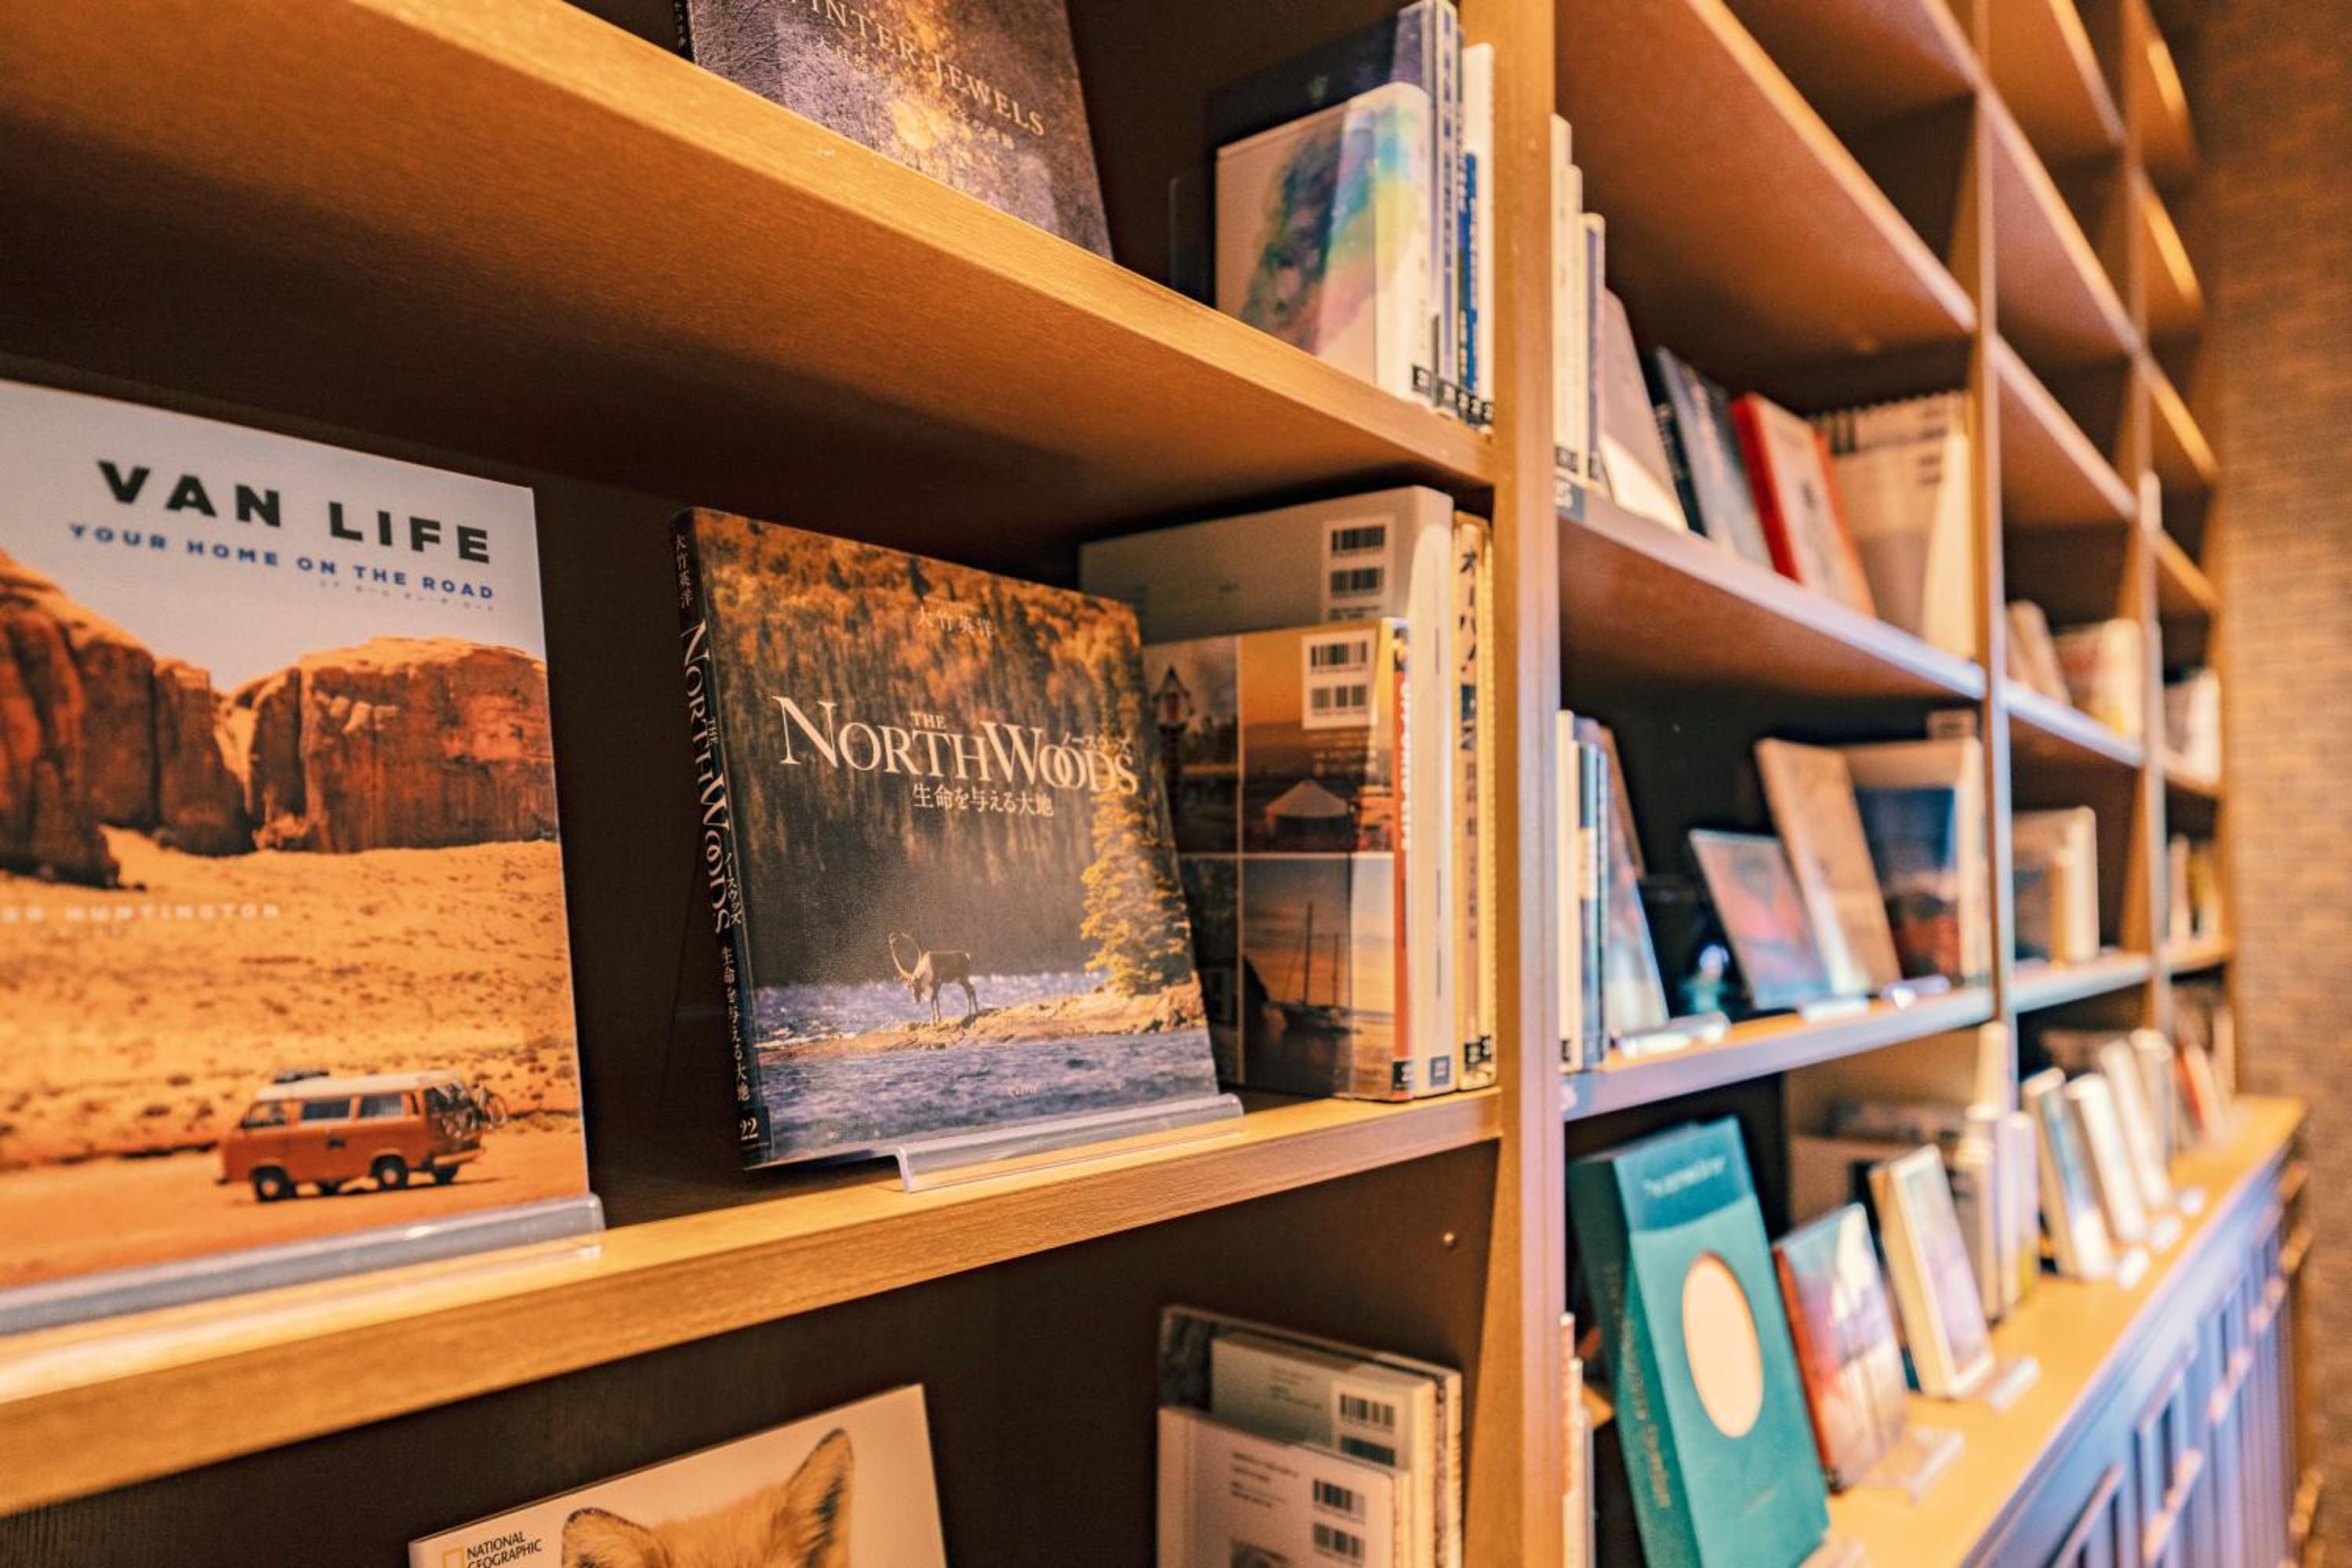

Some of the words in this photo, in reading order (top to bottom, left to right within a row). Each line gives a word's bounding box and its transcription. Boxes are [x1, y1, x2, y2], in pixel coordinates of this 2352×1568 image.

[932, 54, 1045, 136] JEWELS
[97, 459, 281, 528] VAN
[328, 501, 490, 564] LIFE
[70, 524, 166, 550] YOUR
[187, 539, 278, 567] HOME
[296, 557, 336, 575] ON
[353, 565, 407, 586] THE
[423, 575, 494, 599] ROAD
[910, 711, 946, 730] THE
[912, 782, 1054, 817] 生命を与える大地
[466, 1531, 526, 1559] NATIONAL
[468, 1538, 543, 1568] GEOGRAPHIC
